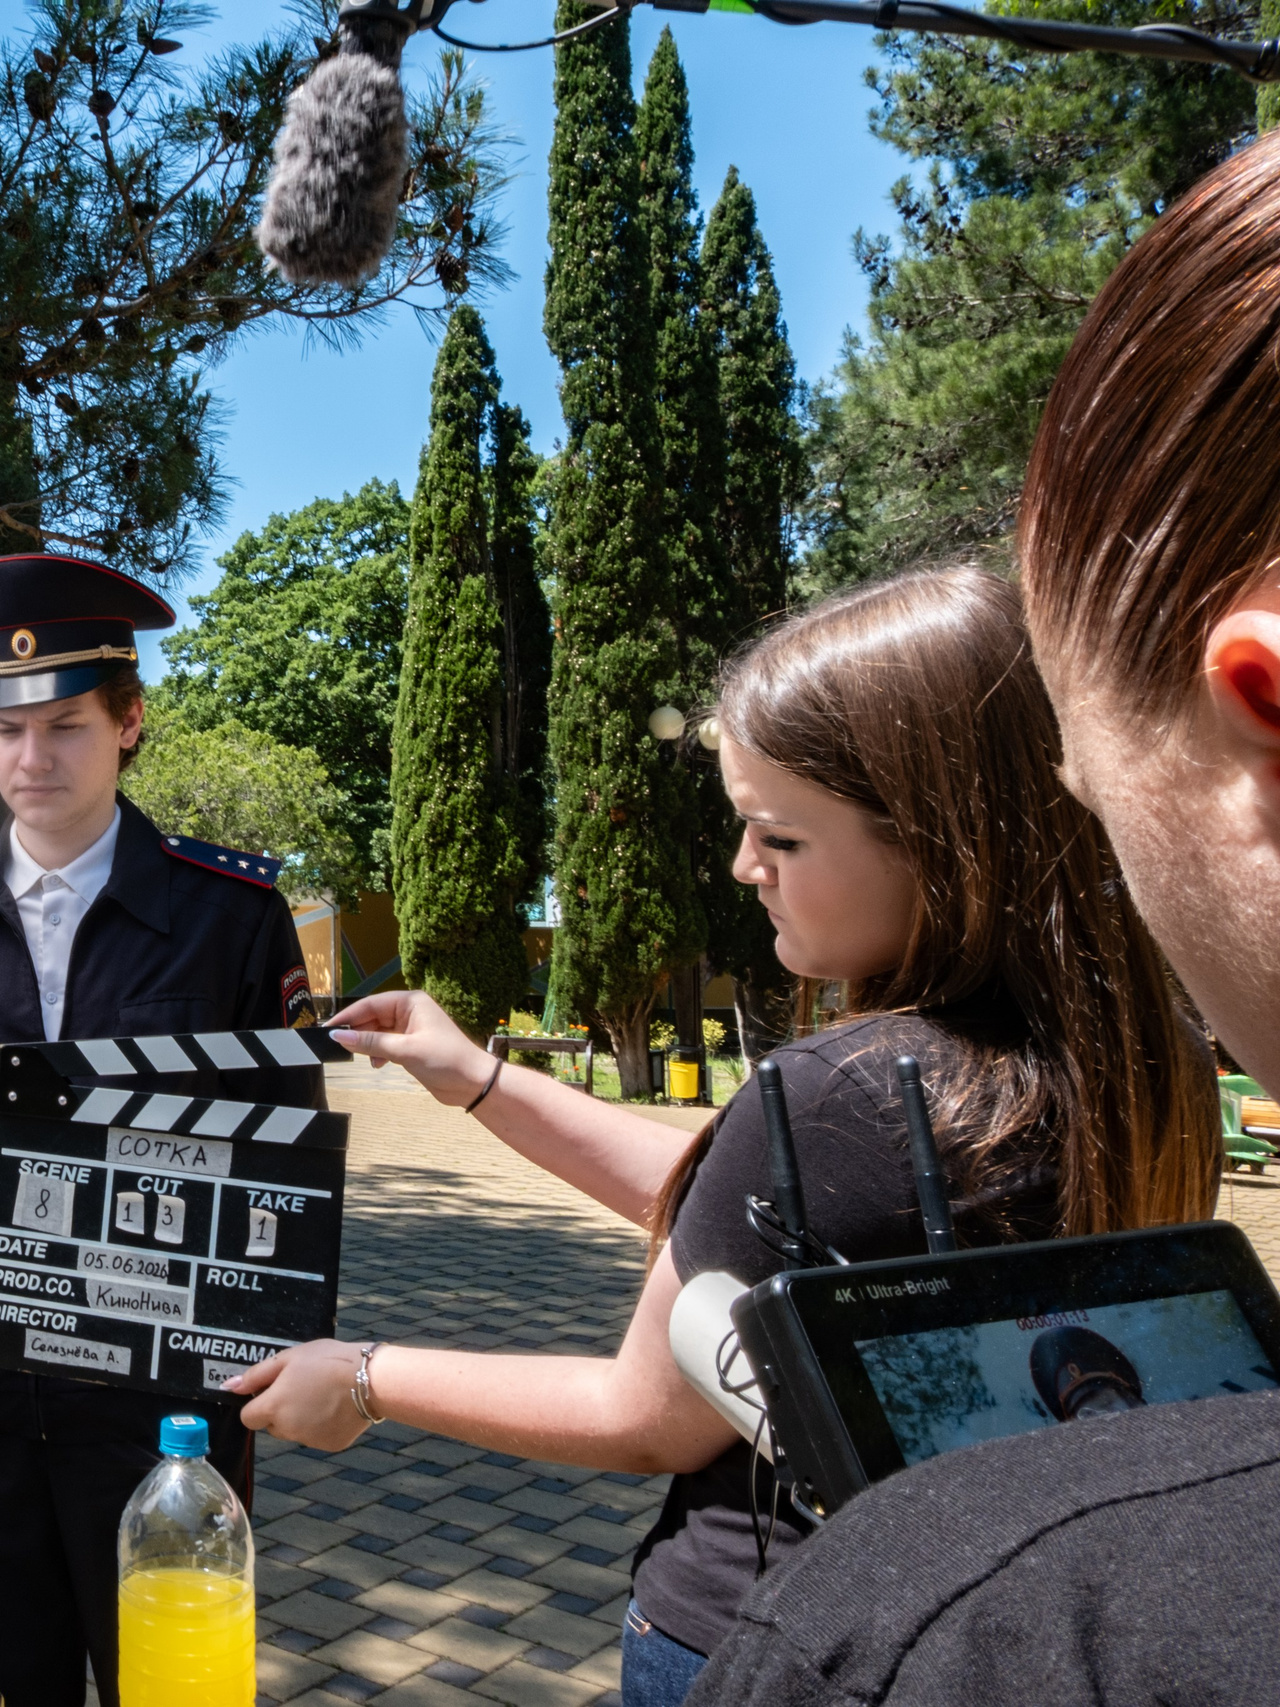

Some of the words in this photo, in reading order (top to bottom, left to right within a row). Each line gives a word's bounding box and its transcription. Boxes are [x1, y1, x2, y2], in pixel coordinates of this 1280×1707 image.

[118, 1134, 207, 1167] СОТКА
[18, 1159, 92, 1184] SCENE
[137, 1175, 183, 1196] CUT
[34, 1188, 51, 1219] 8
[246, 1190, 306, 1214] TAKE
[255, 1216, 267, 1241] 1
[206, 1267, 263, 1292] ROLL
[834, 1288, 857, 1304] 4K
[867, 1277, 951, 1301] Ultra-Bright
[168, 1332, 279, 1363] CAMERAMA
